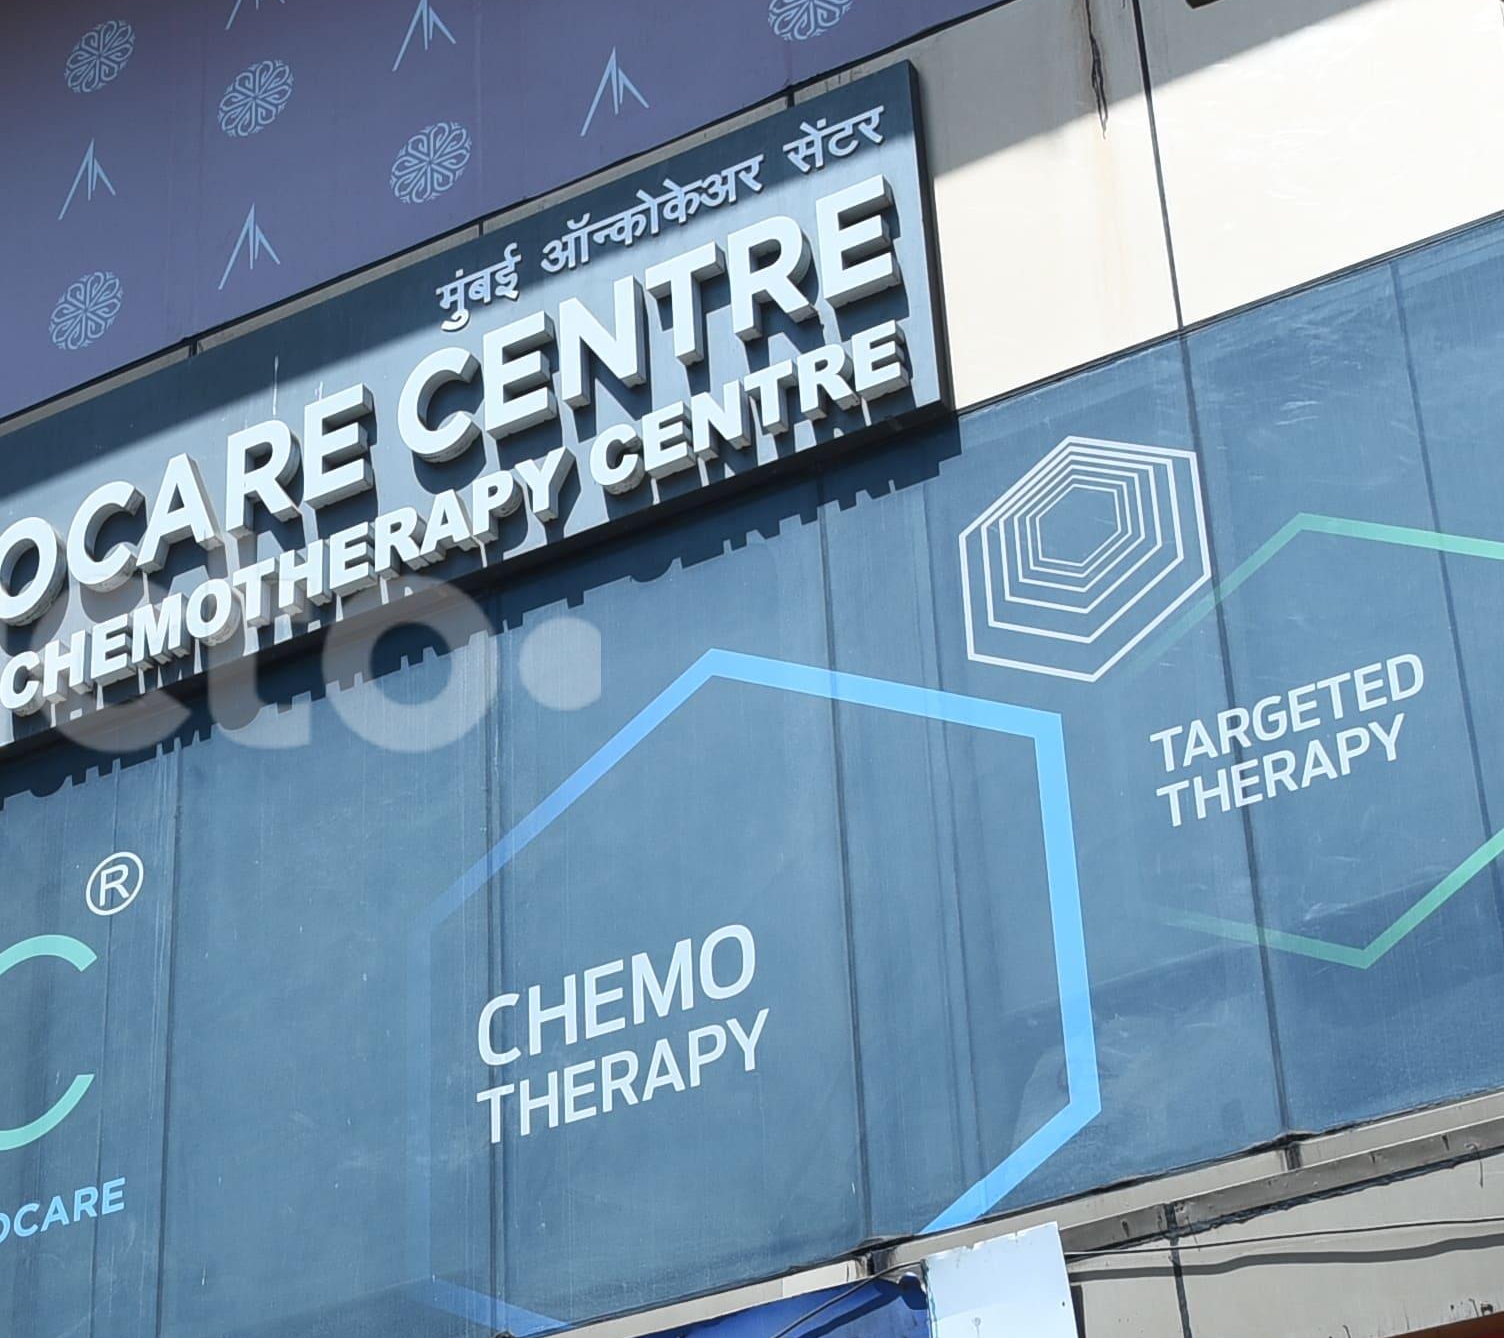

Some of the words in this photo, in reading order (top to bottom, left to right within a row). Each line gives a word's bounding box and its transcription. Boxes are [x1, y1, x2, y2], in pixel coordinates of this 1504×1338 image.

[435, 242, 523, 331] मुंबई
[541, 153, 764, 273] ऑन्कोकेअर
[783, 105, 885, 173] सेंटर
[397, 174, 900, 462] CENTRE
[0, 447, 575, 716] CHEMOTHERAPY
[591, 319, 909, 495] CENTRE
[1150, 653, 1423, 774] TARGETED
[1155, 714, 1406, 827] THERAPY
[476, 923, 757, 1068] CHEMO
[476, 1008, 770, 1145] THERAPY
